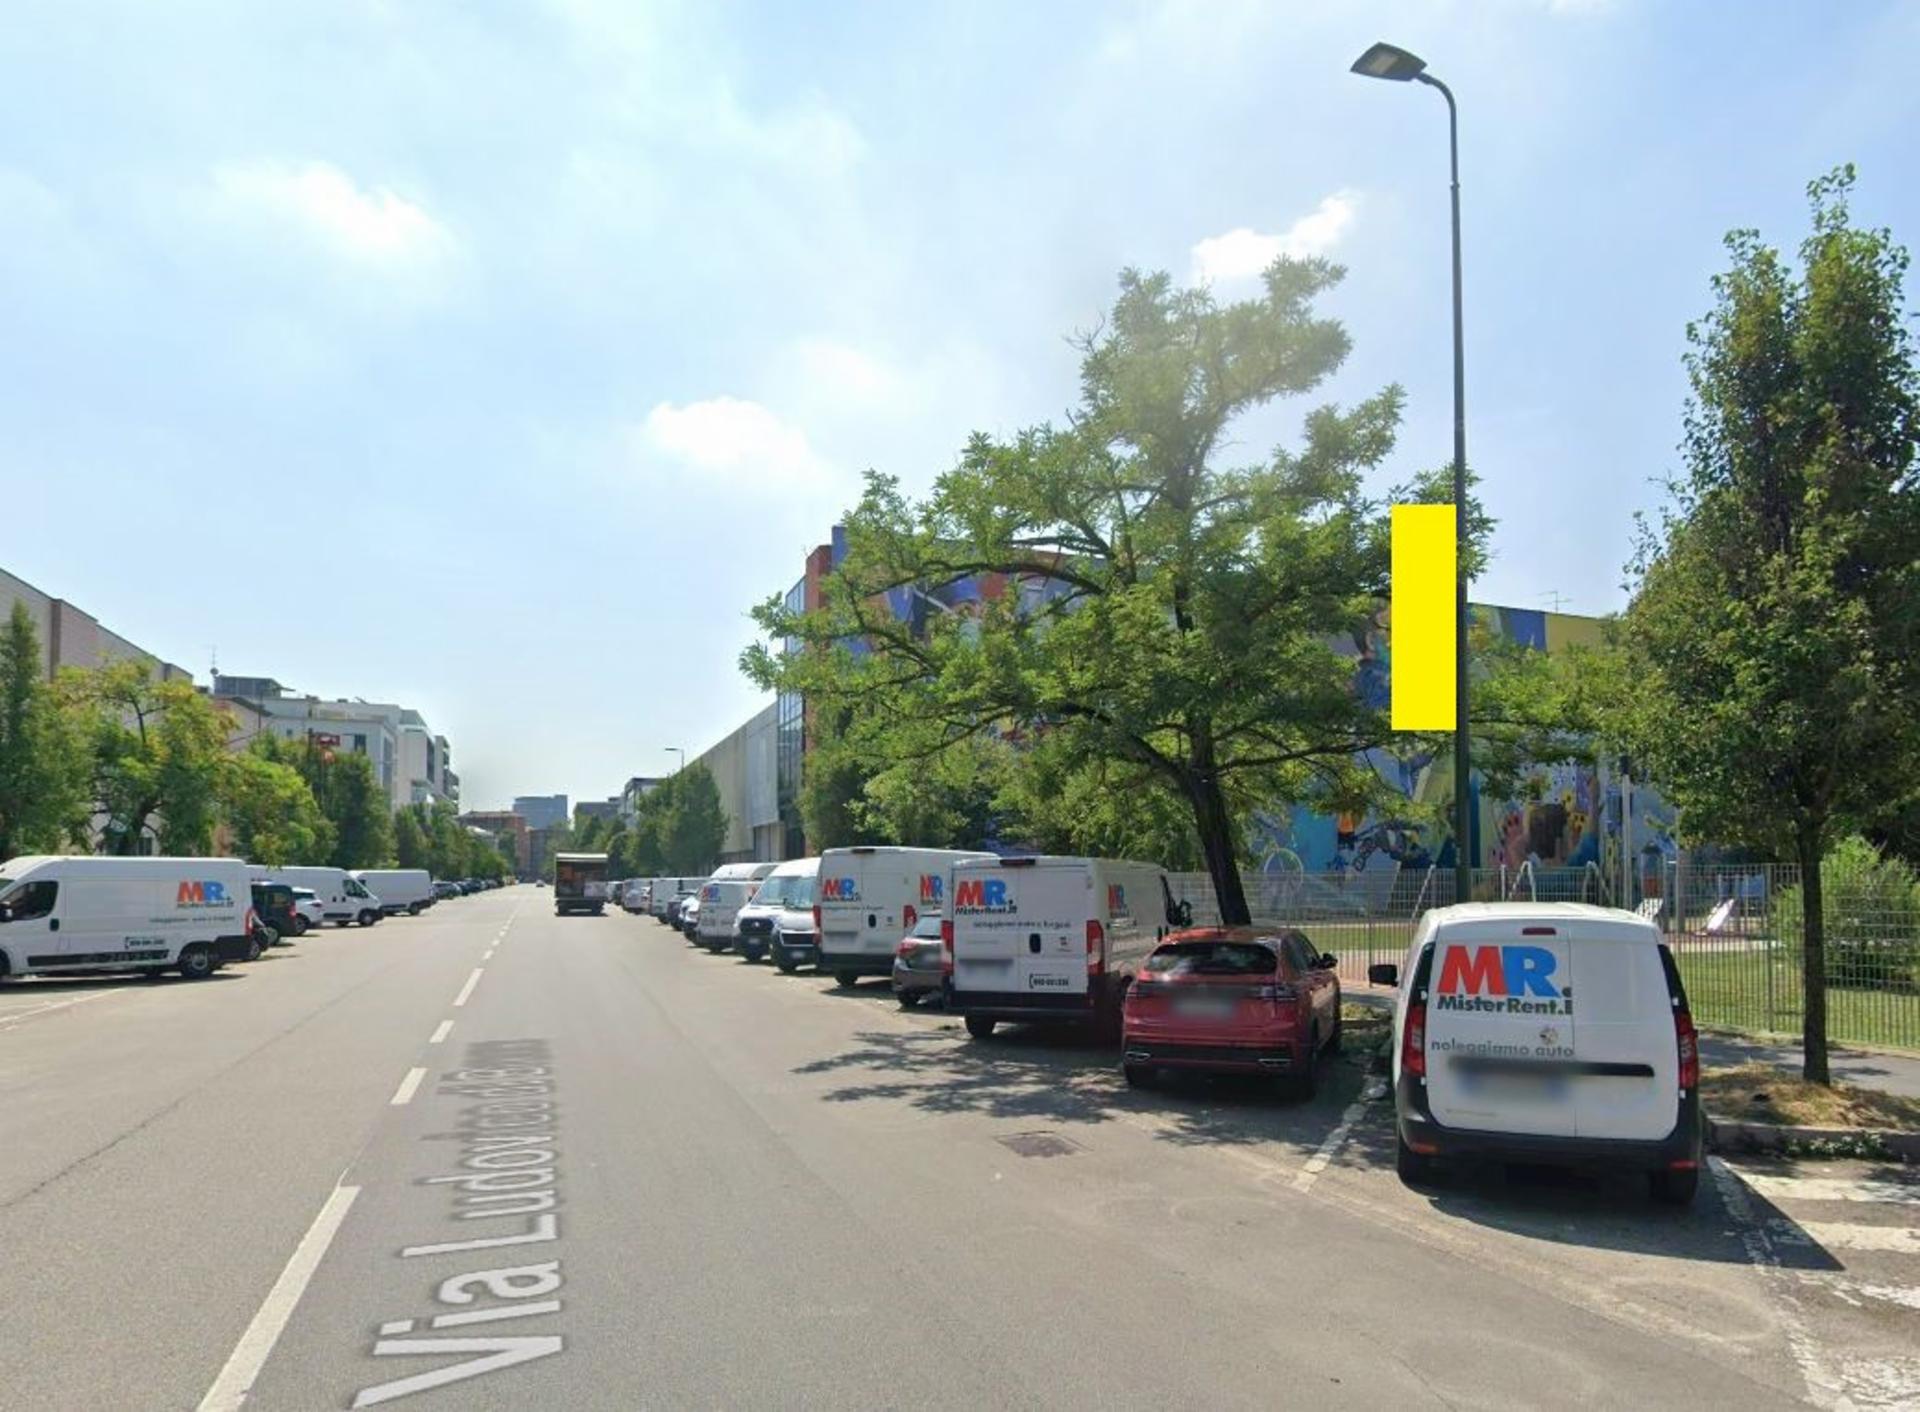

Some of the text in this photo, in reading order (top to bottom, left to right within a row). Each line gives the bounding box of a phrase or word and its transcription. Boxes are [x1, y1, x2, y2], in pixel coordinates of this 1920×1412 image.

[955, 880, 1007, 907] MR
[1437, 945, 1562, 997] MR
[1535, 1045, 1575, 1058] auto
